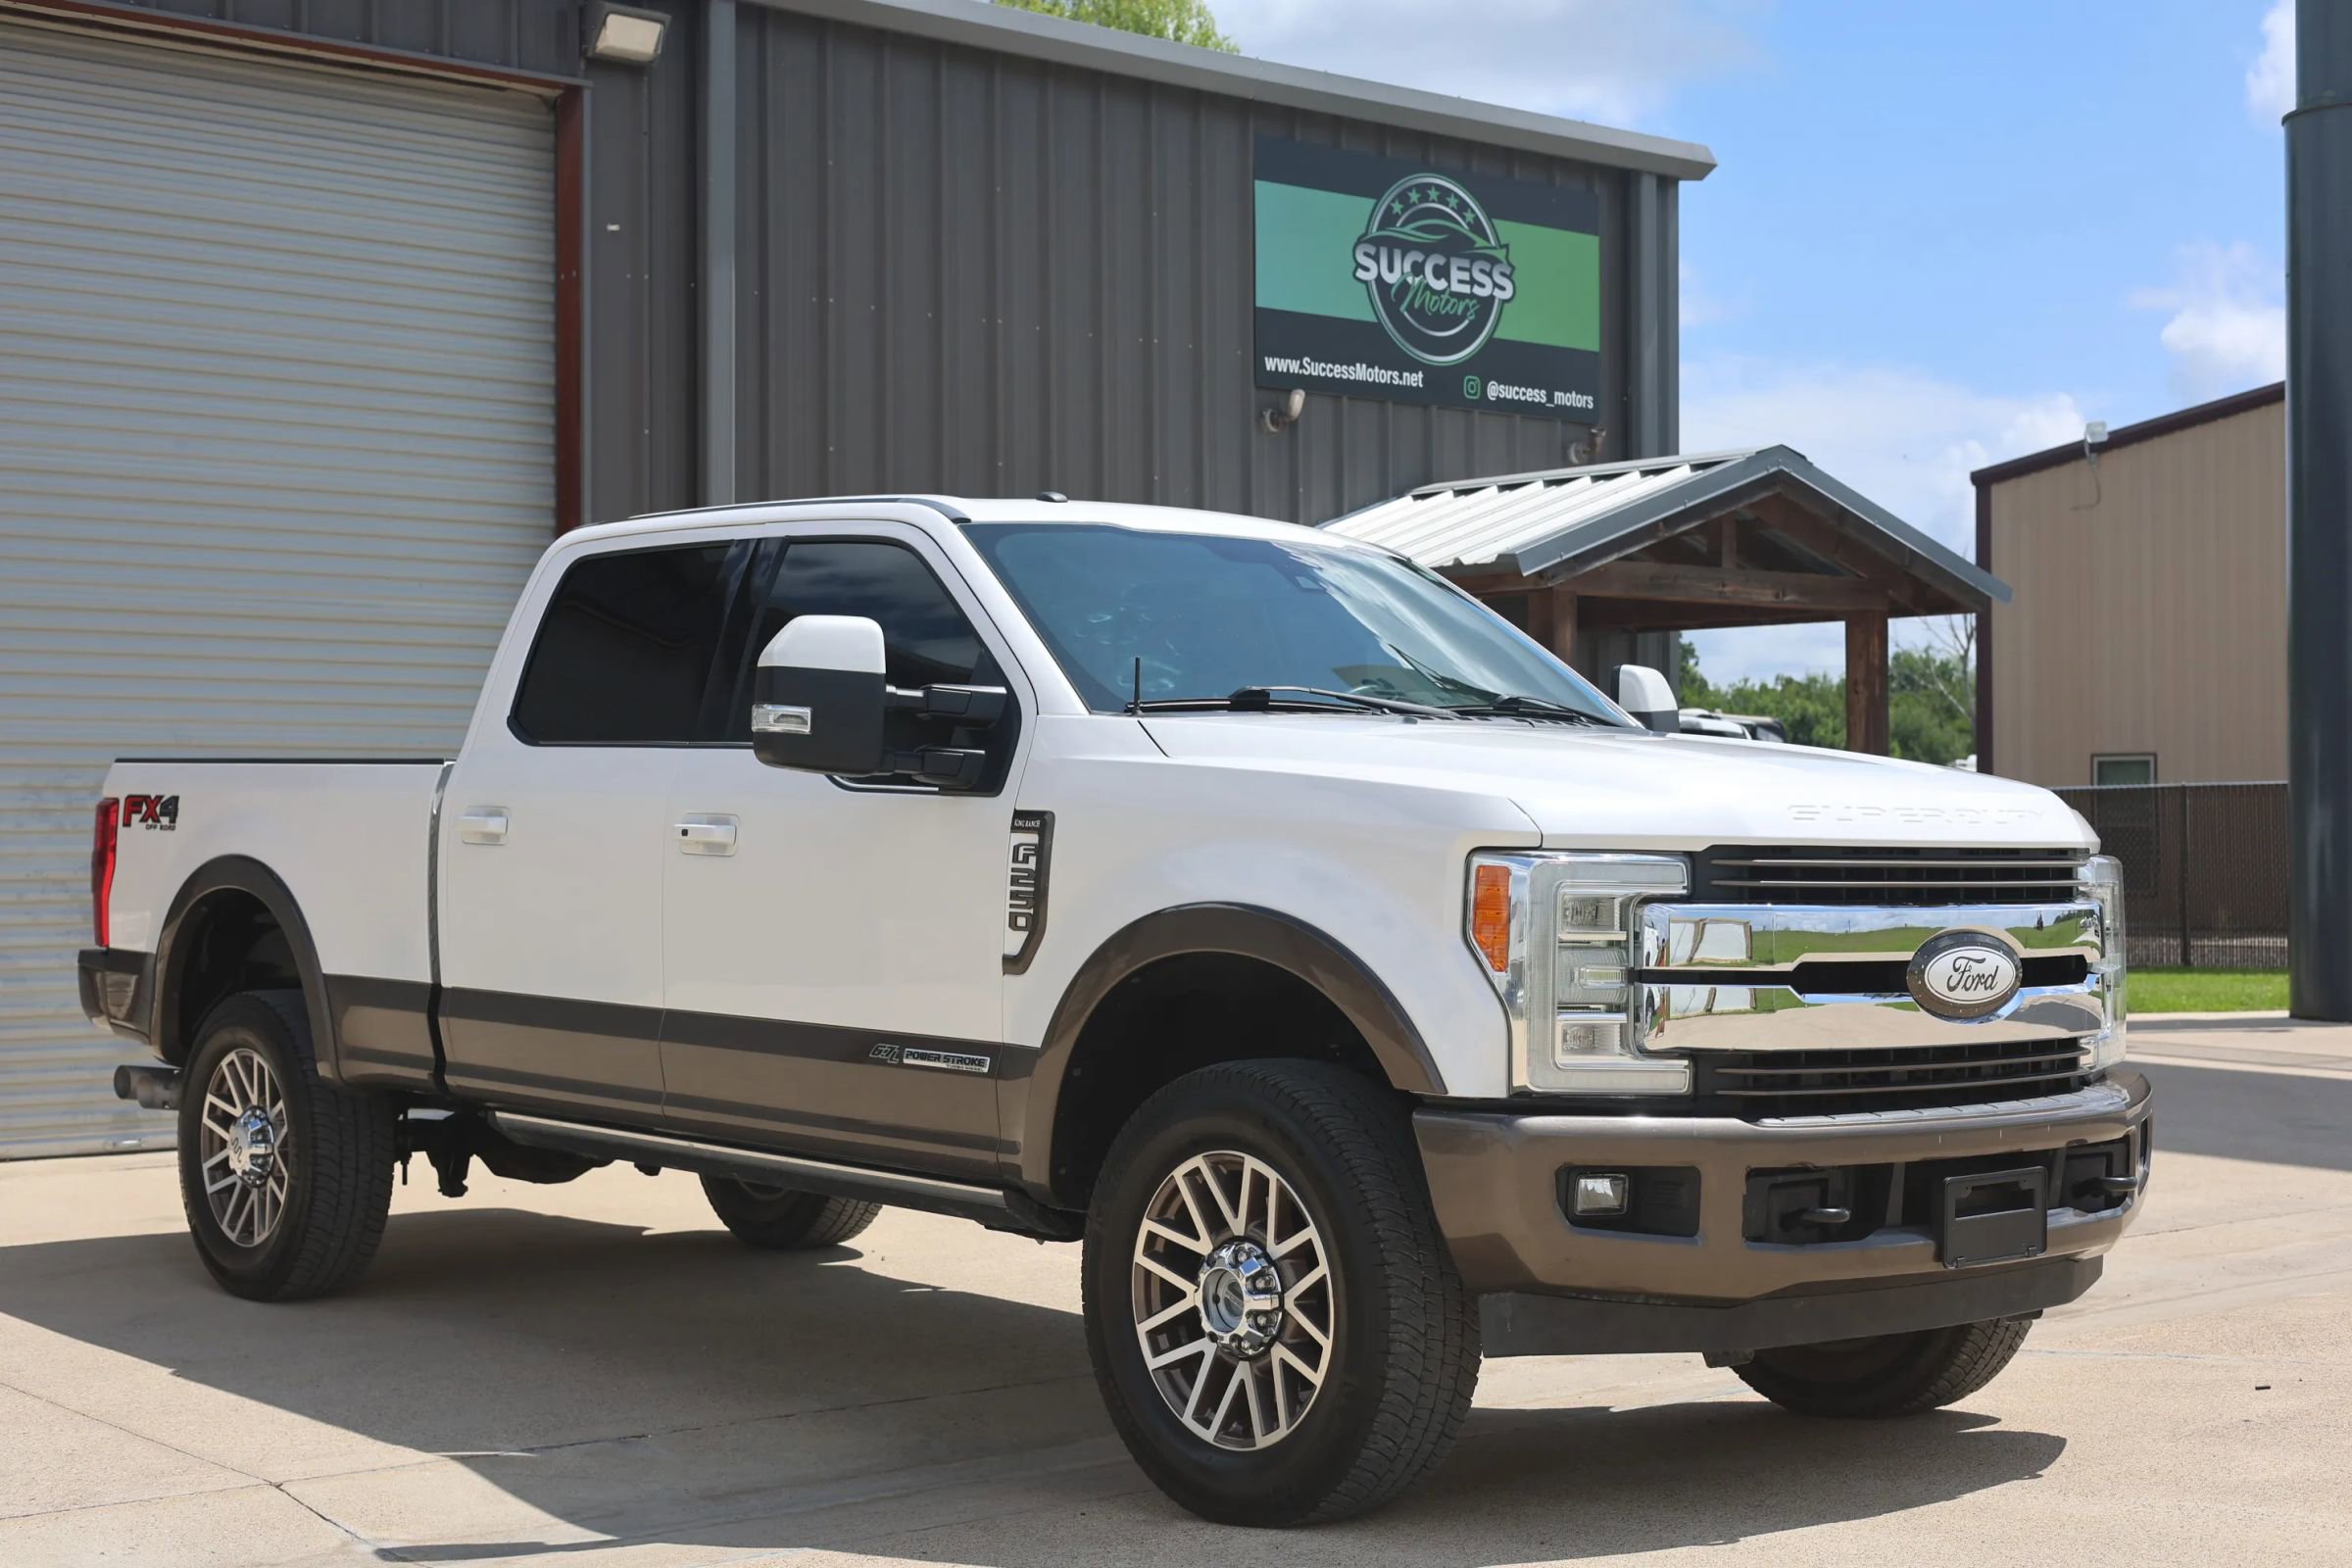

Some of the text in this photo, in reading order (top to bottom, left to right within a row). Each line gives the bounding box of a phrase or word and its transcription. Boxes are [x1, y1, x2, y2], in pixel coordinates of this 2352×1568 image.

[1355, 243, 1514, 300] SUCCESS
[1391, 270, 1481, 320] Motors
[1264, 356, 1424, 388] www.SuccessMotors.net
[1487, 380, 1594, 410] @success_motors
[122, 795, 180, 828] FX4
[1946, 956, 1999, 993] Ford
[905, 1050, 941, 1063] POWER
[942, 1054, 986, 1068] STROKE
